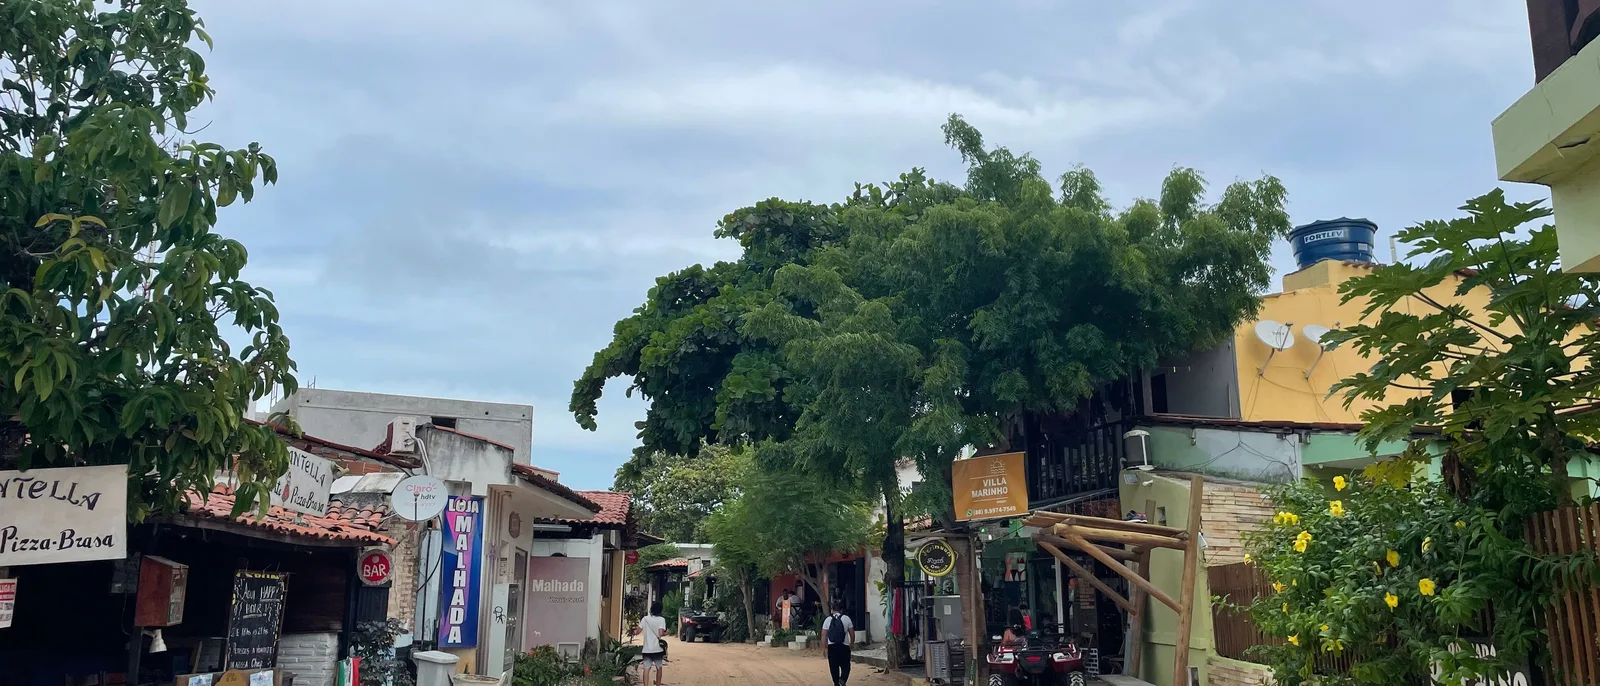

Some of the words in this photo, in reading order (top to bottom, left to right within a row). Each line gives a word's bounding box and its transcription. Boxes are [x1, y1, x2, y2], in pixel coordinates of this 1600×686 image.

[1305, 230, 1343, 242] FORTLEV
[405, 483, 433, 492] Claro
[983, 477, 1007, 487] VILLA
[971, 486, 1008, 498] MARINHO
[448, 498, 480, 514] LOJA
[0, 525, 114, 554] Pizza-Brasa
[363, 564, 388, 577] BAR
[447, 515, 473, 644] MALHADA
[532, 579, 584, 592] Malhada
